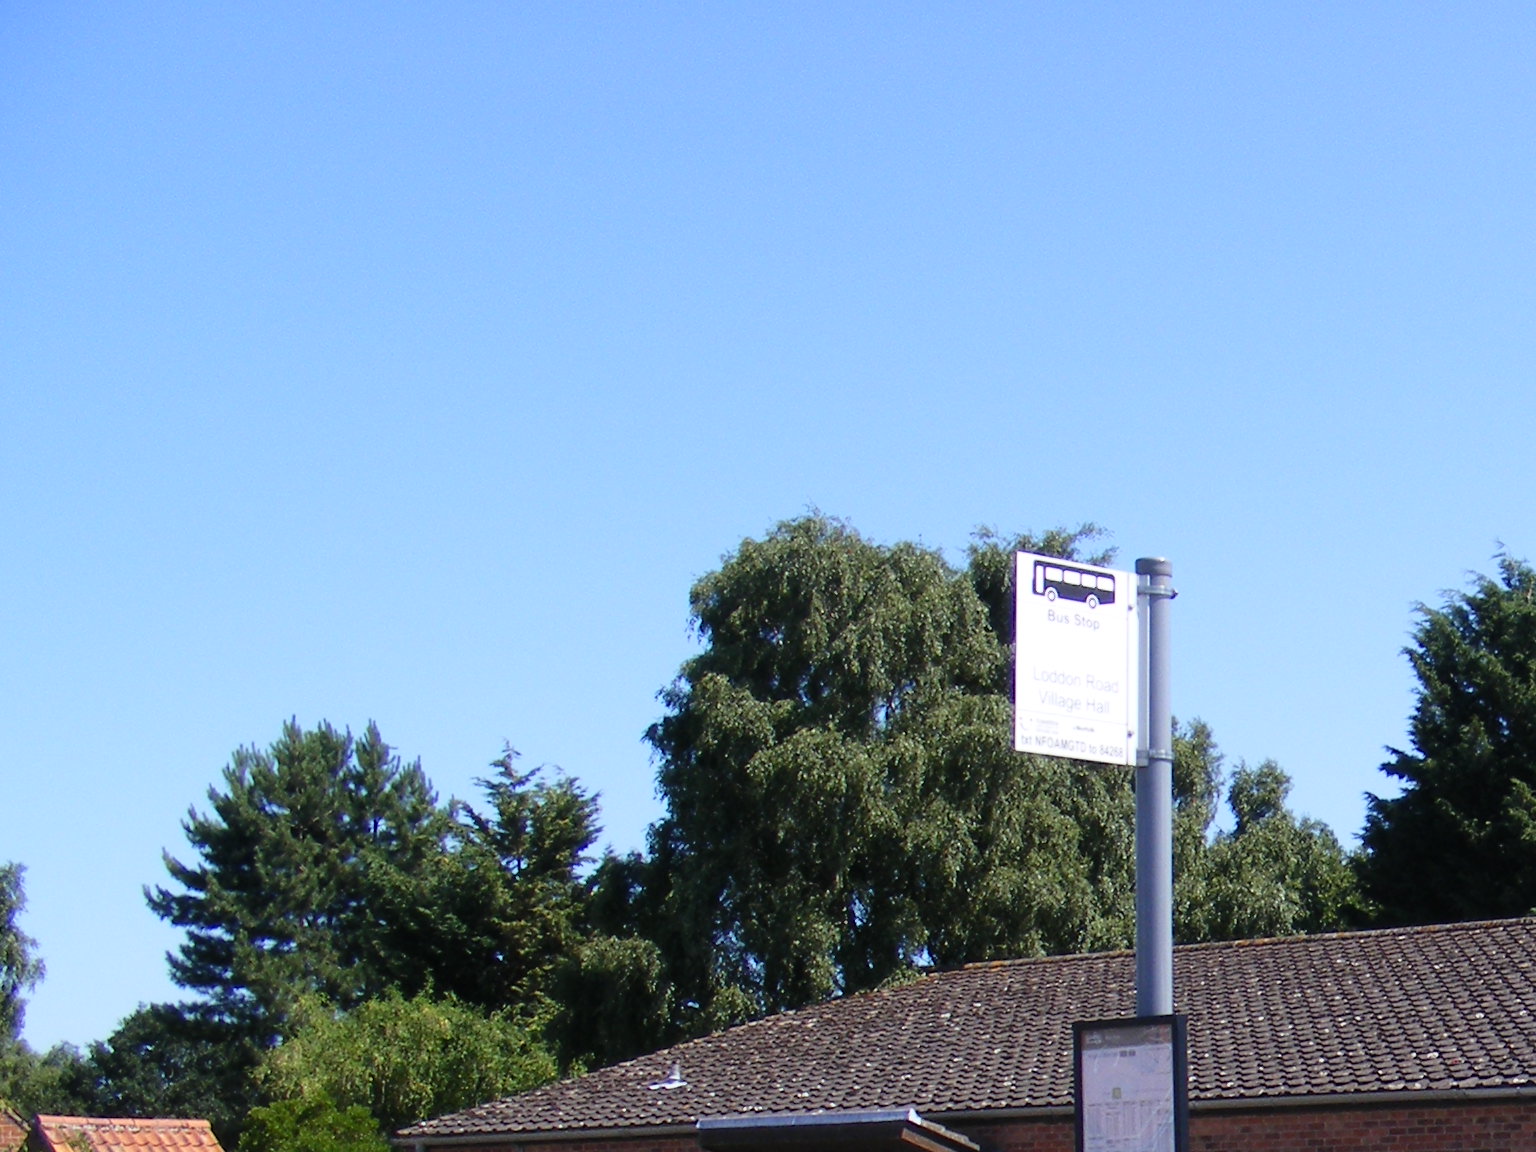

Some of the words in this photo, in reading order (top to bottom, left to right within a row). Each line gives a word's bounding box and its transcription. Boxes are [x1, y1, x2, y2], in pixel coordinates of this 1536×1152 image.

[1047, 609, 1070, 624] Bus
[1074, 614, 1100, 630] Stop
[1033, 665, 1081, 687] Loddon
[1086, 674, 1119, 693] Road
[1038, 689, 1081, 713] Village
[1086, 698, 1110, 714] Hall
[1021, 735, 1032, 745] txt
